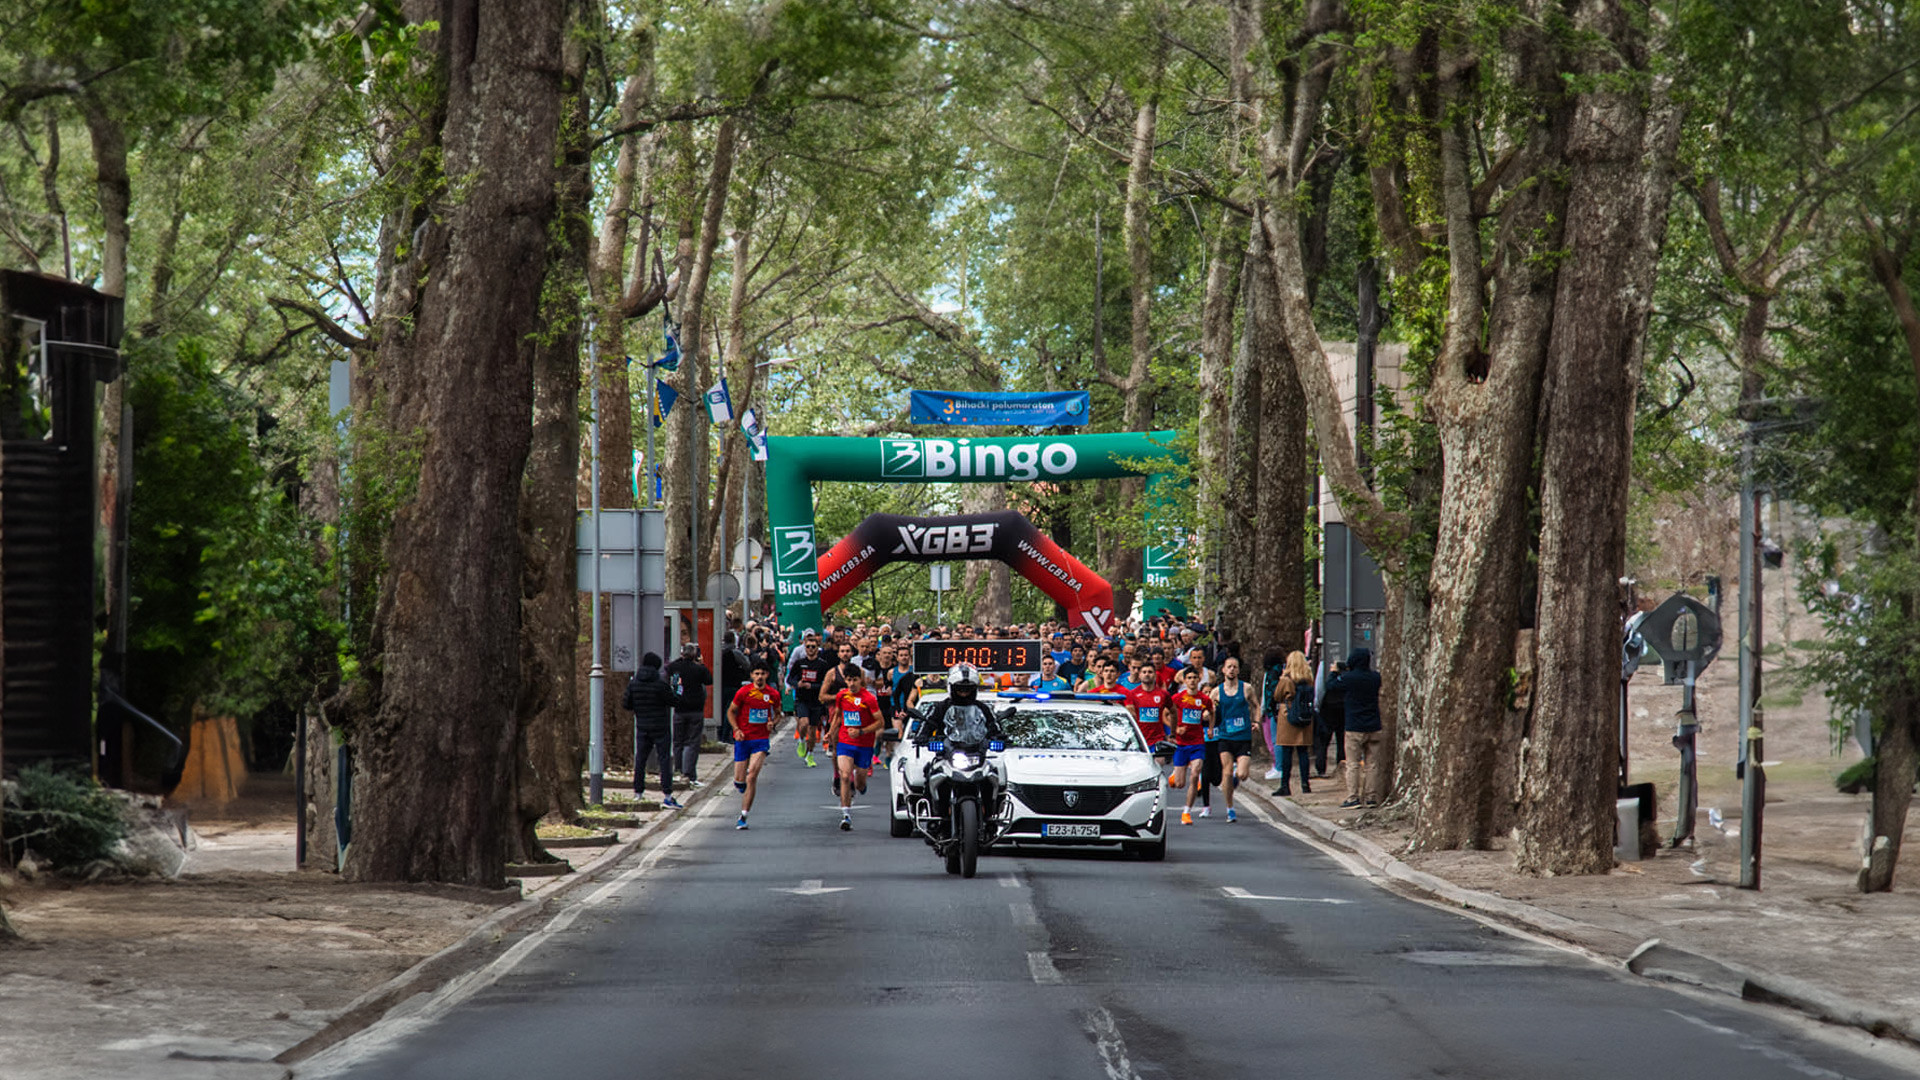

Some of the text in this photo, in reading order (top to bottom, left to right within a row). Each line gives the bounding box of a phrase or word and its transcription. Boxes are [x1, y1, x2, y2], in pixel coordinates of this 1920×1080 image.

[992, 401, 1054, 411] polumaraton
[925, 438, 1077, 481] Bingo
[819, 545, 876, 593] WW.GB3.BA
[1018, 540, 1082, 591] WWW.GB3.BA
[778, 580, 819, 596] Bingo
[1048, 825, 1099, 836] E23-A-754
